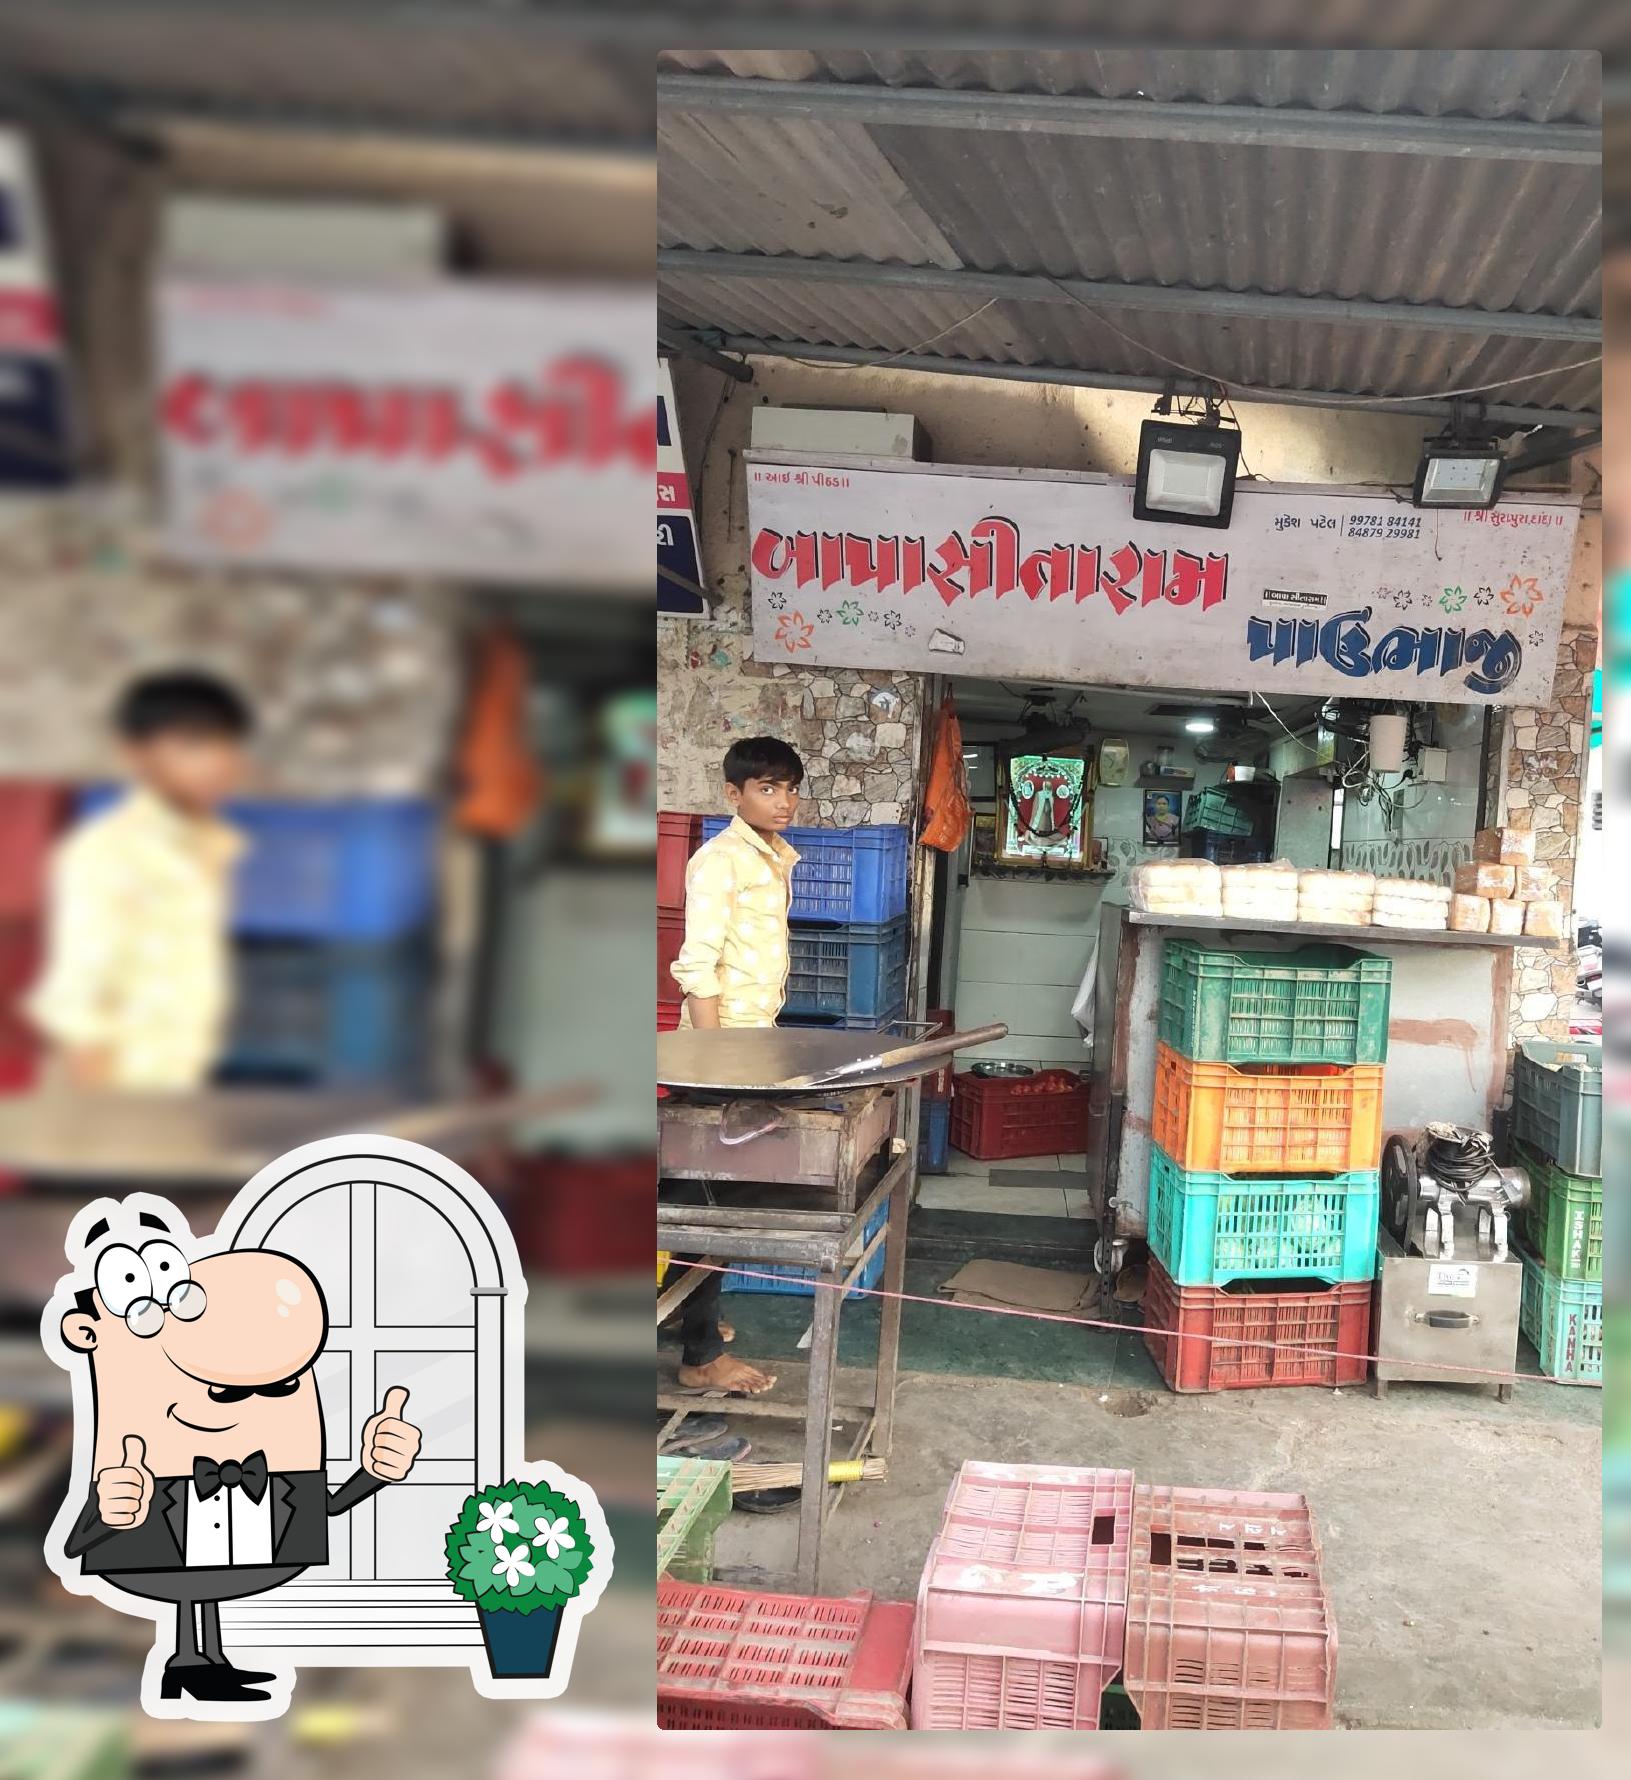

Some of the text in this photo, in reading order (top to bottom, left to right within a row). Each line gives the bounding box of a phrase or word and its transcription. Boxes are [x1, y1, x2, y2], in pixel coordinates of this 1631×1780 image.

[1274, 514, 1336, 531] મુકેશ પટેલ
[1347, 528, 1421, 539] 84879 29981
[1349, 515, 1422, 528] 99781 84141
[751, 516, 1229, 615] બાપાસીતારામ
[1247, 606, 1522, 694] પાઉભાજી
[1565, 1314, 1578, 1372] KANHA
